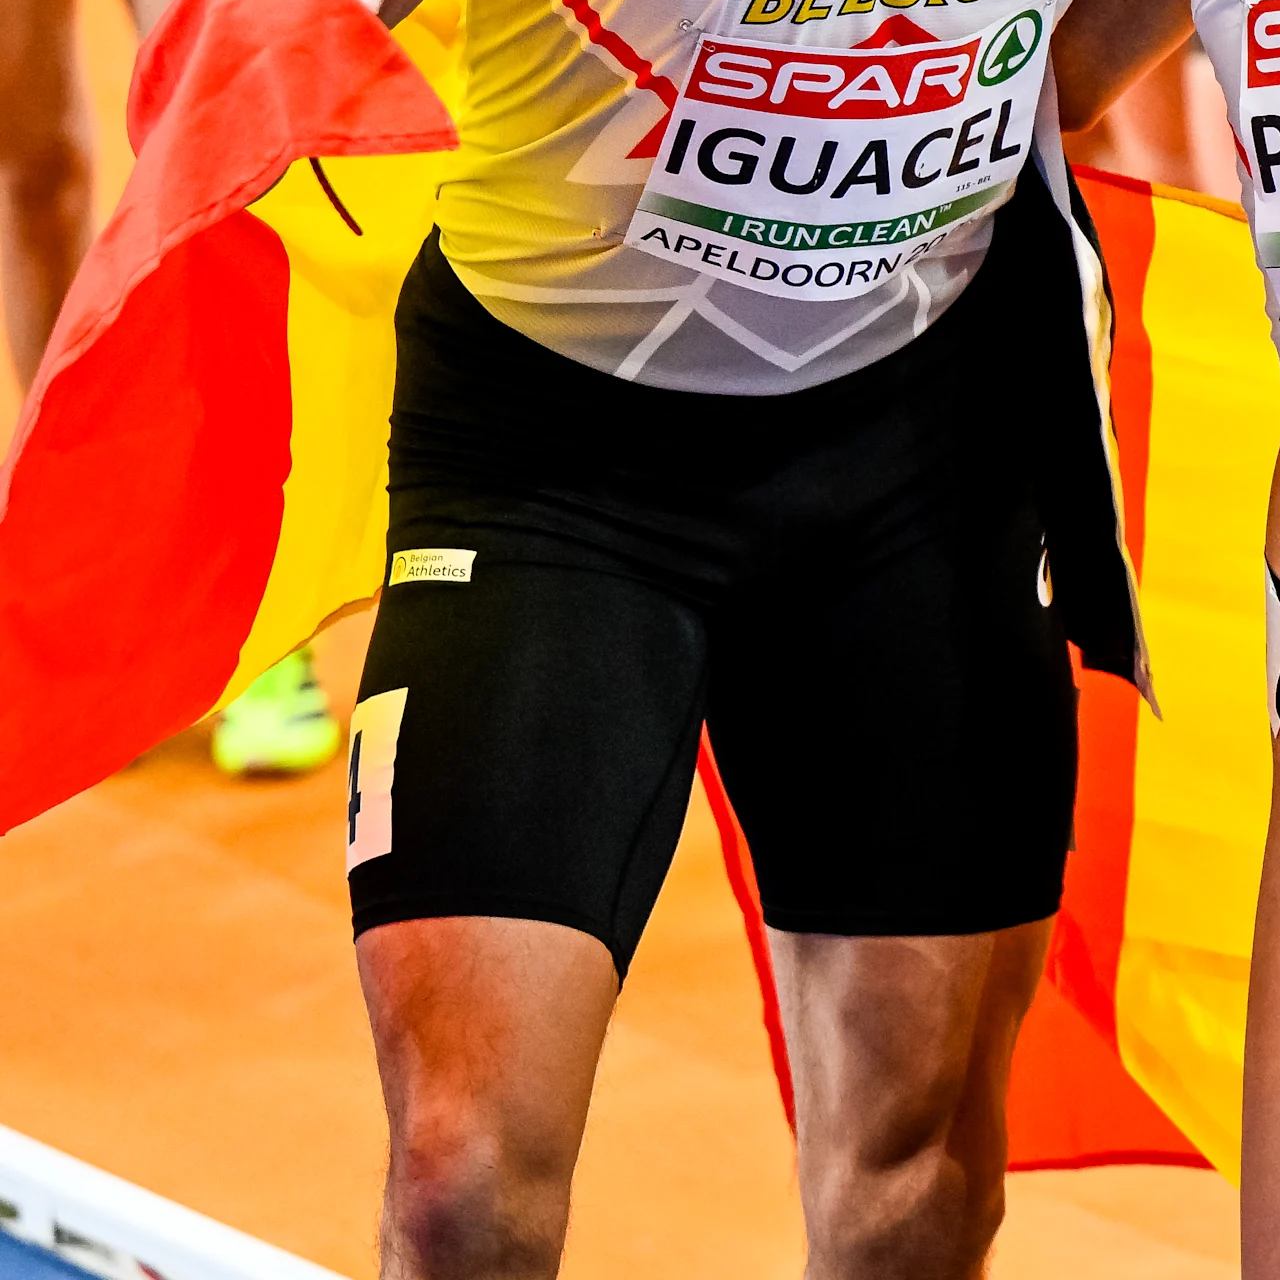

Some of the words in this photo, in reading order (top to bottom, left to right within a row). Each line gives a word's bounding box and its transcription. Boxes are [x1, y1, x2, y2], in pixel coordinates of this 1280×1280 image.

[698, 51, 973, 110] SPAR
[664, 99, 1021, 199] IGUACEL
[722, 215, 734, 233] I
[740, 218, 821, 248] RUN
[640, 226, 903, 287] APELDOORN
[407, 564, 467, 578] Athletics
[410, 553, 444, 563] Belgian
